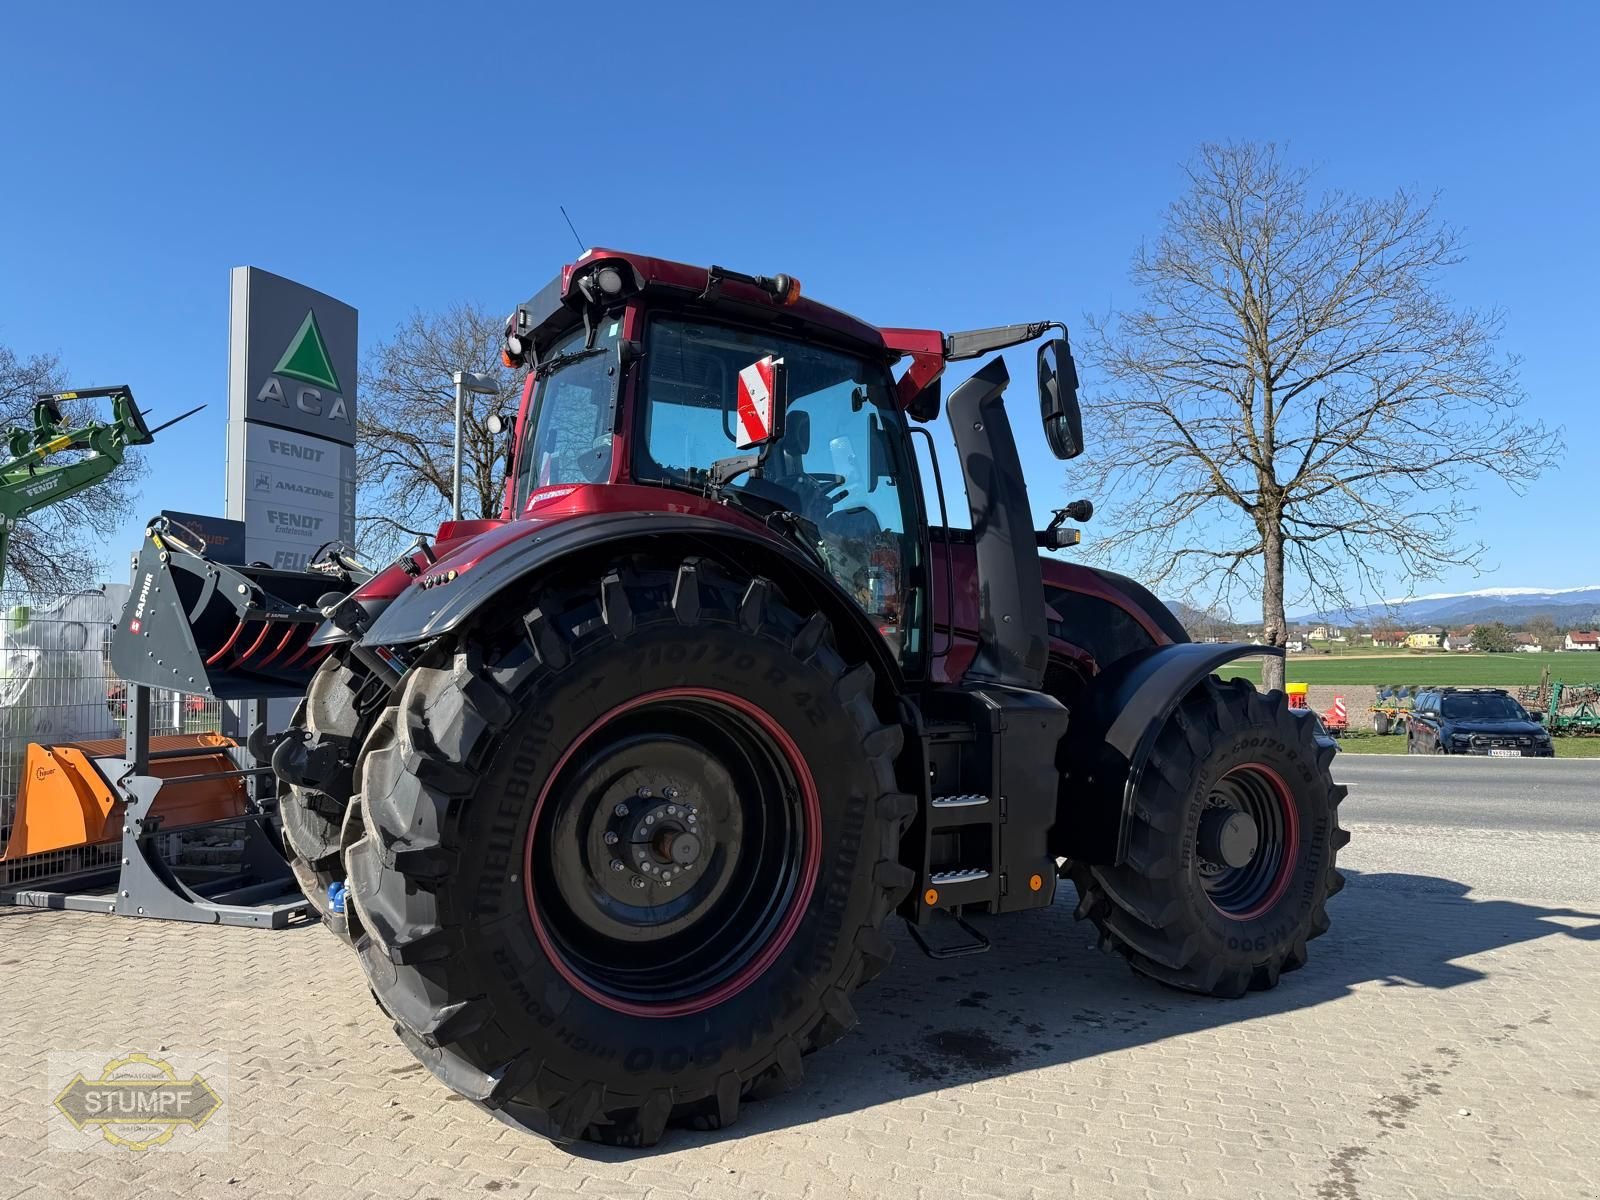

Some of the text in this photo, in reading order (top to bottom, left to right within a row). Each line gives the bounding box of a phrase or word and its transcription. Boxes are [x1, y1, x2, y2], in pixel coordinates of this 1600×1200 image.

[256, 376, 350, 425] ACA
[268, 439, 325, 463] FENDT
[26, 478, 59, 497] FENDT
[275, 481, 335, 499] AMAZONE
[266, 510, 323, 530] FENDT
[135, 572, 154, 619] SAPHIR
[476, 712, 554, 914] TRELLEBORG
